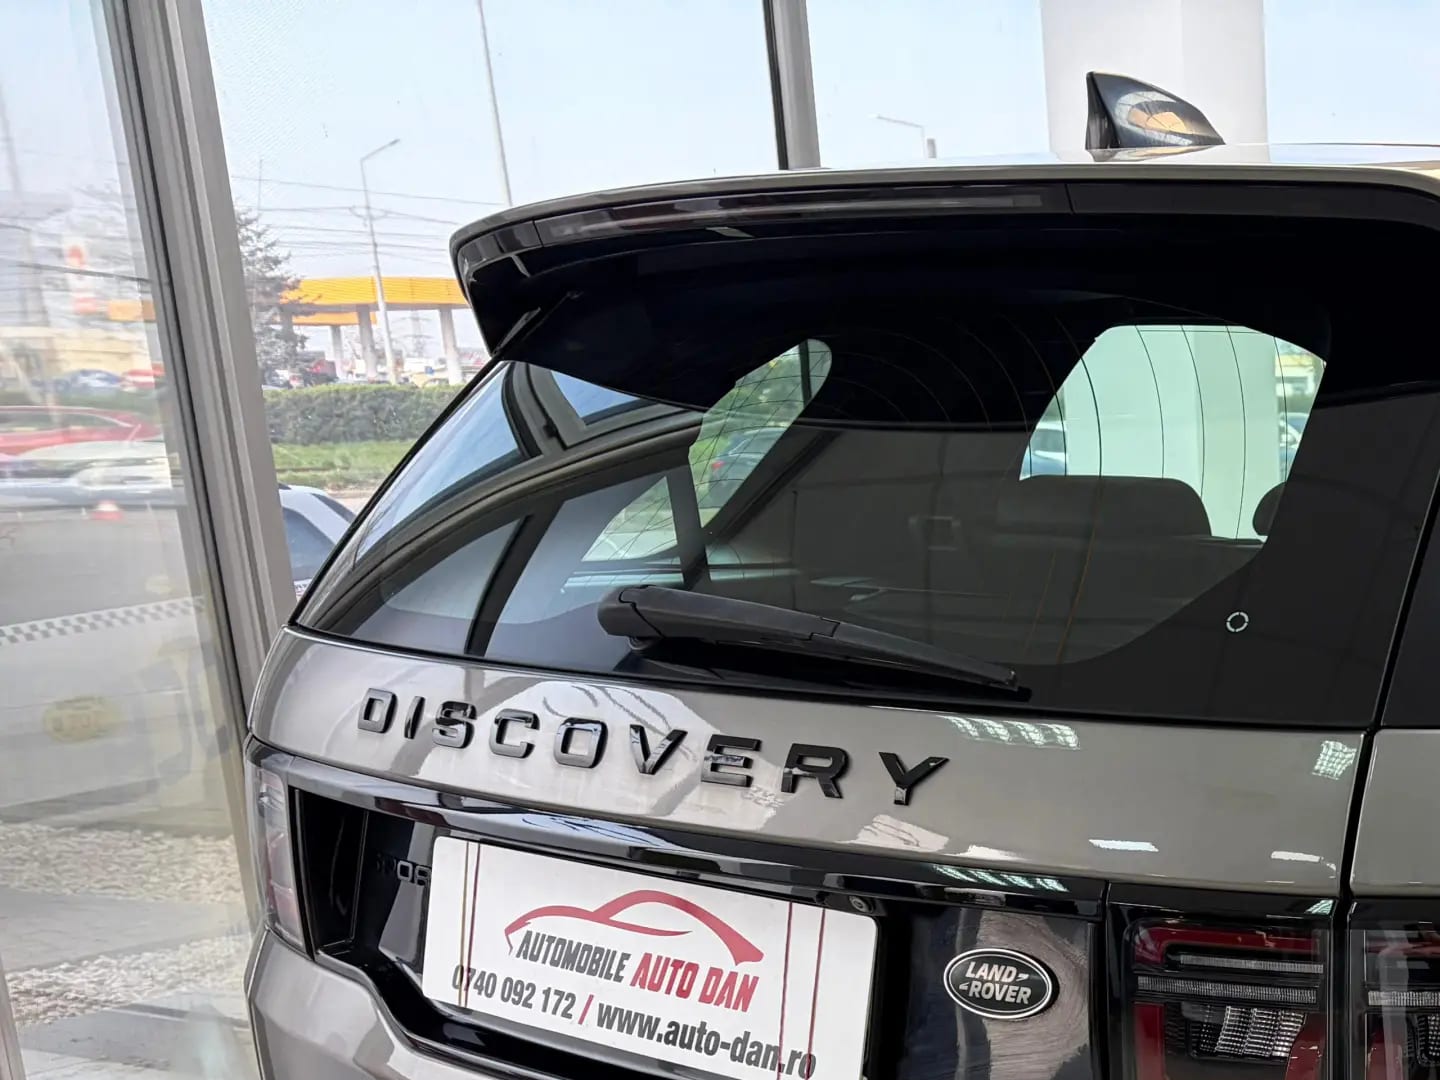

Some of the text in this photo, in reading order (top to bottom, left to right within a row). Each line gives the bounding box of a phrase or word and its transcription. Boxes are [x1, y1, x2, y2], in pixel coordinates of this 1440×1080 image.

[357, 688, 950, 806] DISCOVERY
[516, 929, 760, 1012] AUTOMOBILE AUTO DAN
[965, 961, 1017, 983] LAND
[968, 980, 1032, 1005] ROVER
[451, 964, 498, 999] 0740
[500, 976, 536, 1010] 092
[542, 987, 577, 1020] 172
[596, 1002, 817, 1080] www.auto-dan.ro
